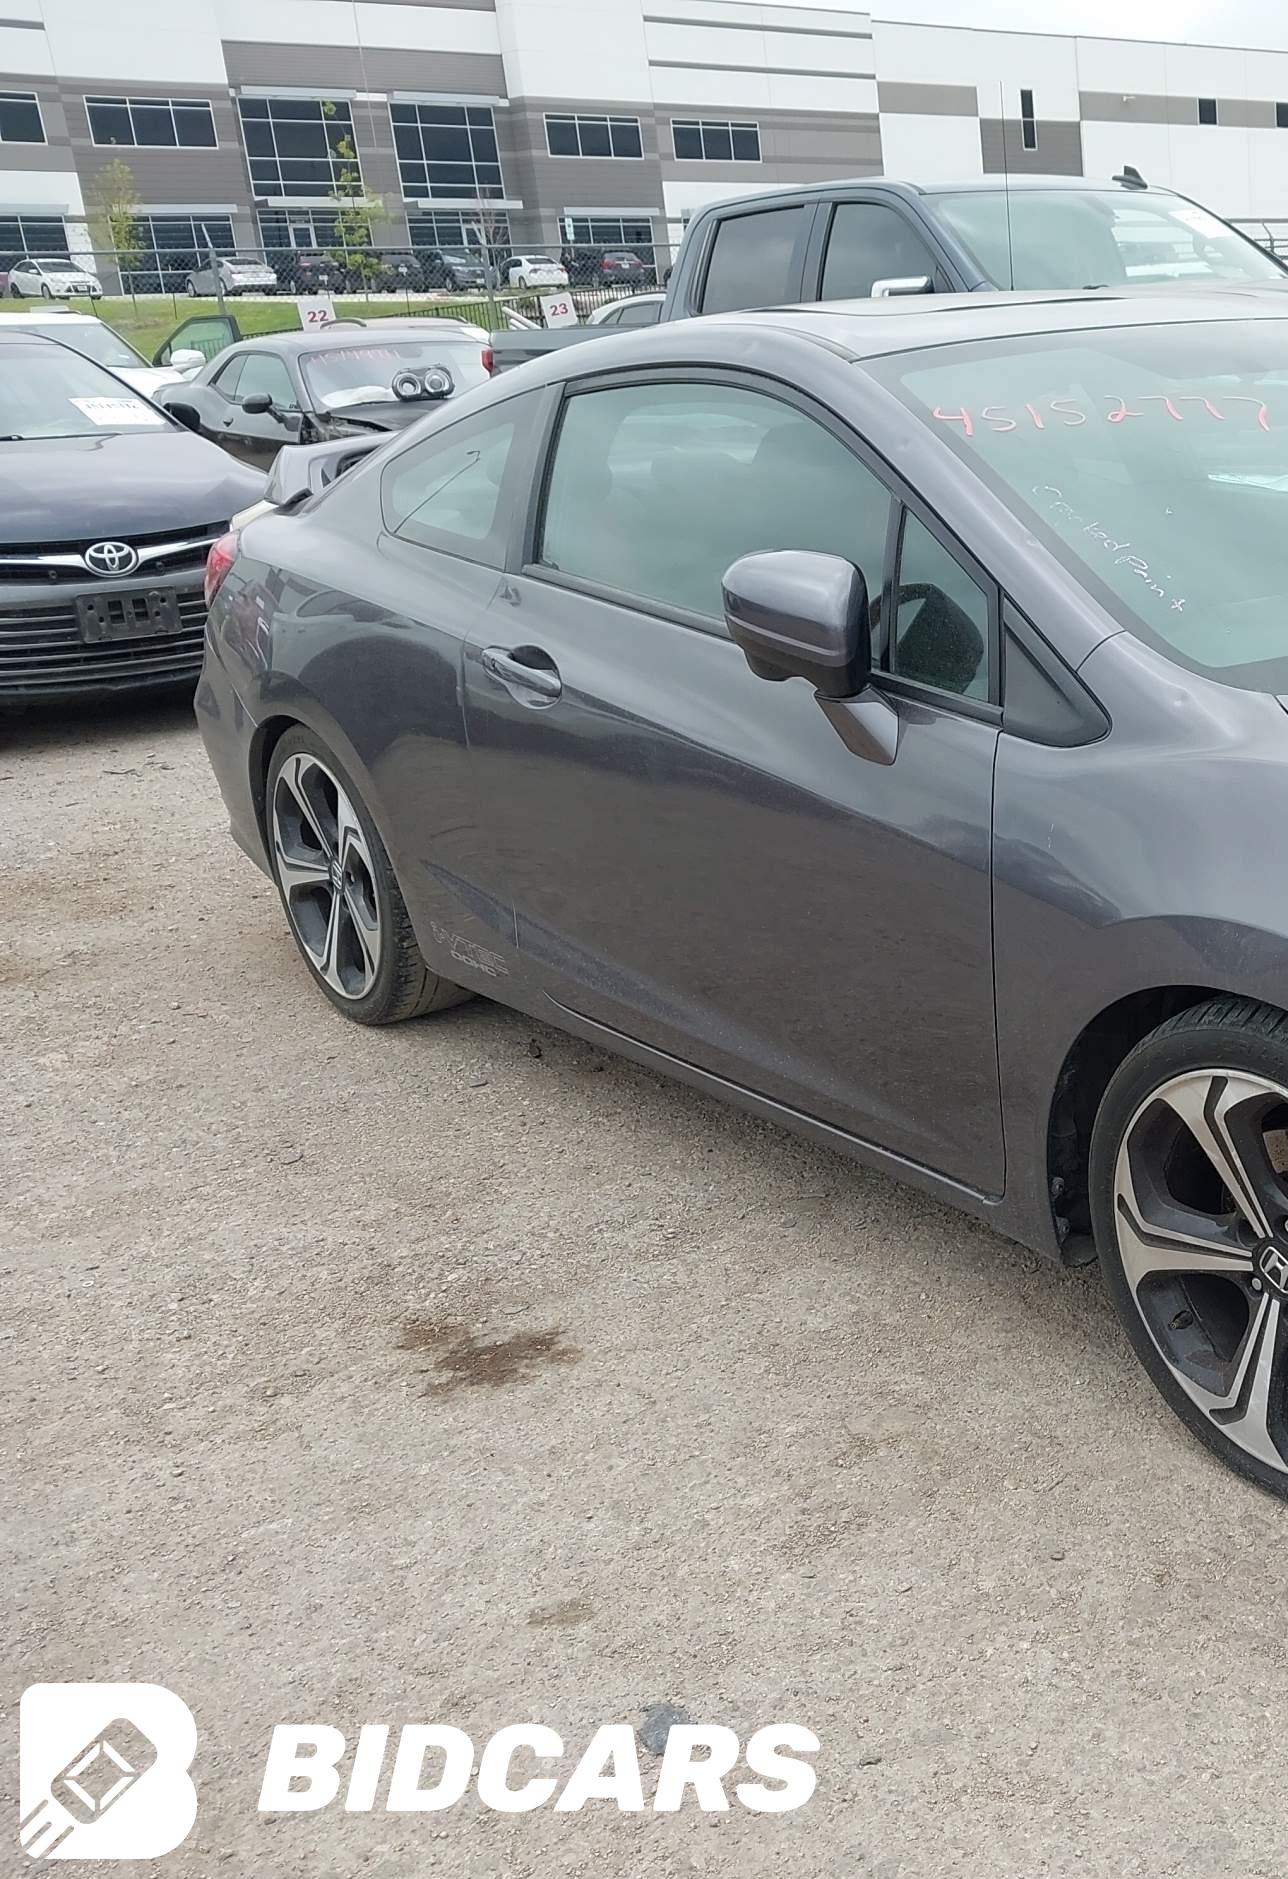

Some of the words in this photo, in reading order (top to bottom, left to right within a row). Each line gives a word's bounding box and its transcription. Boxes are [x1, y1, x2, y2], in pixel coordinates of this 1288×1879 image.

[550, 303, 569, 316] 23
[307, 310, 329, 323] 22
[932, 395, 1270, 437] 45152777
